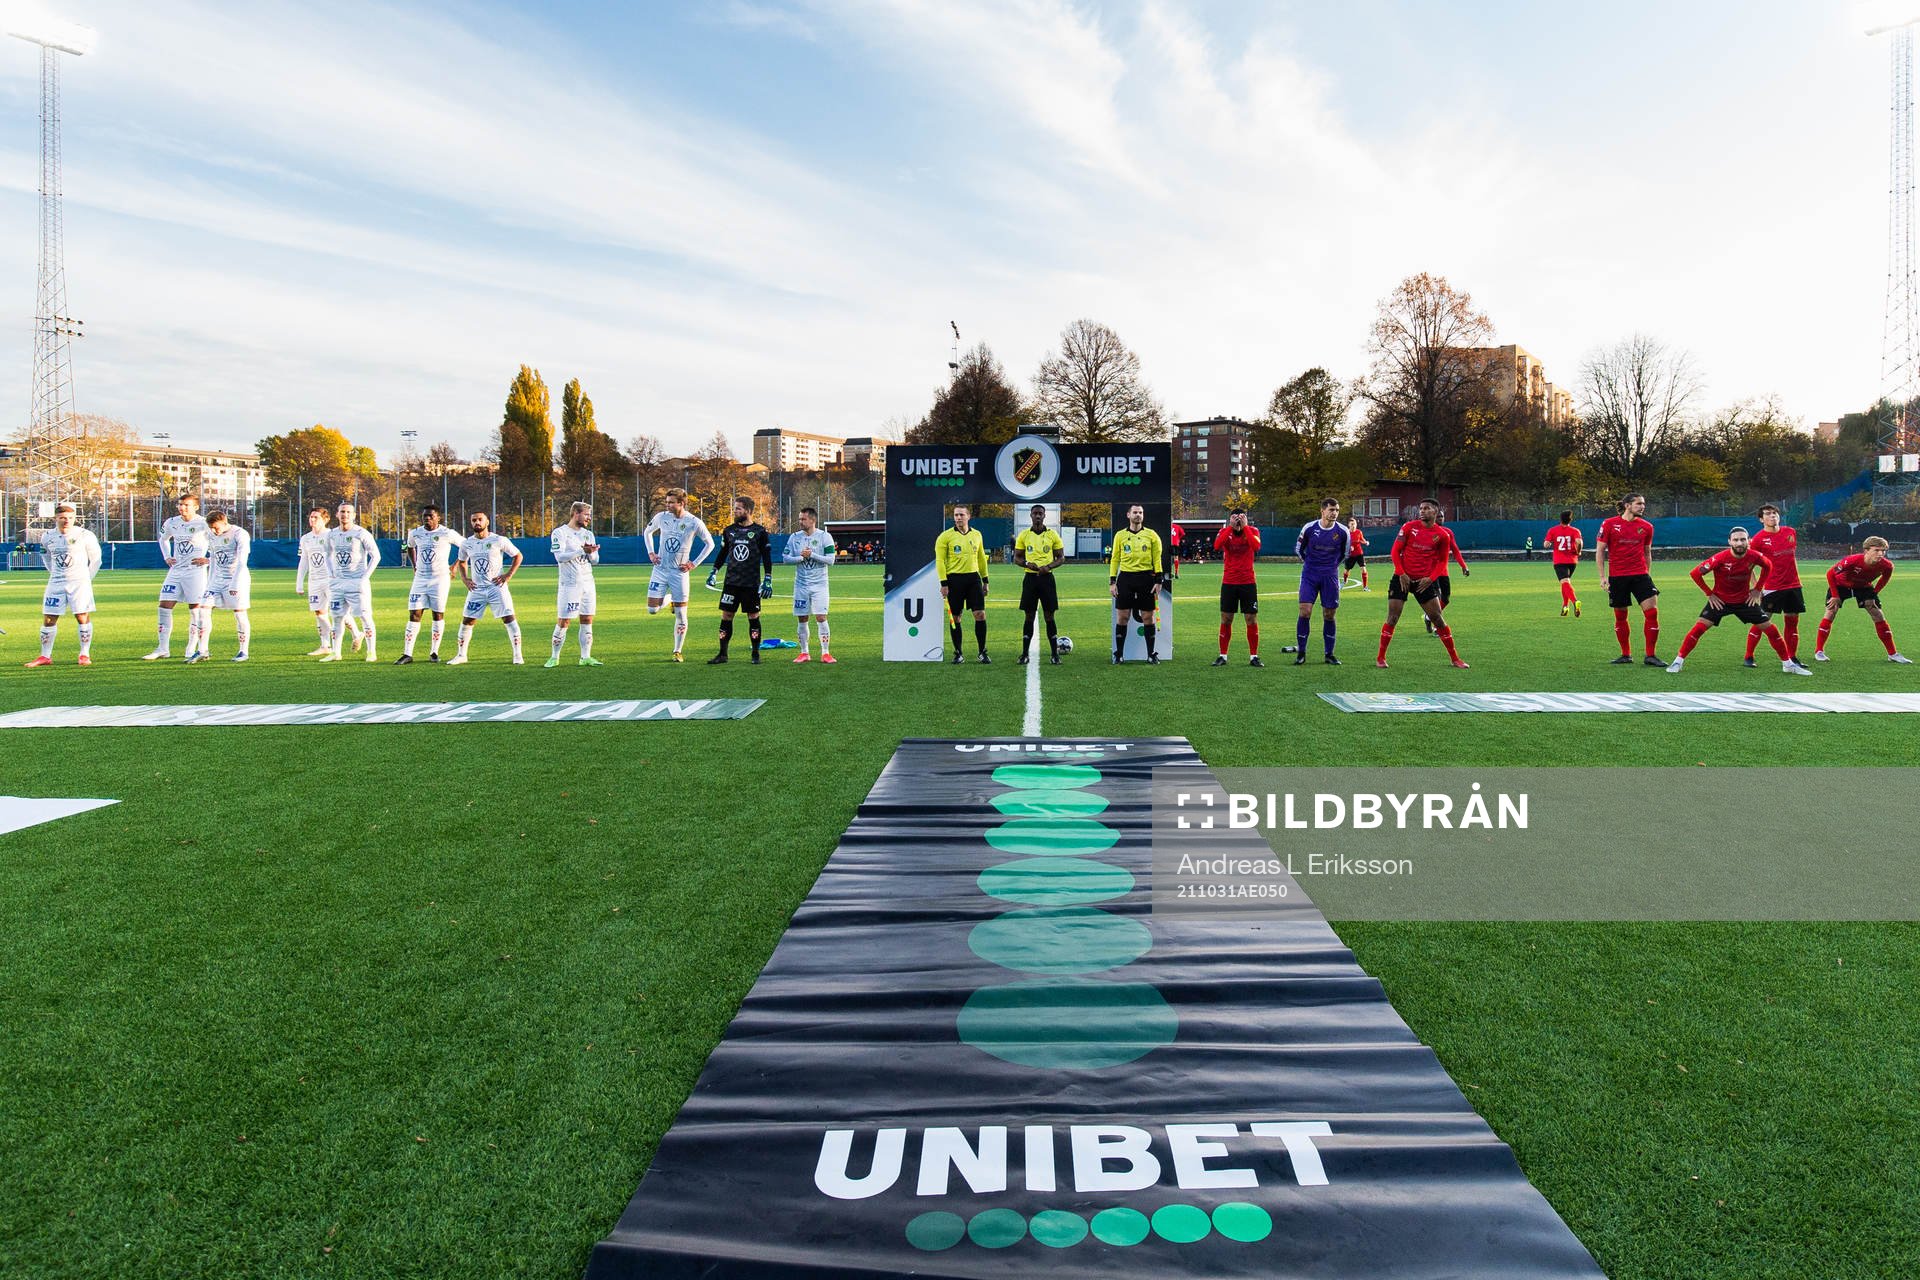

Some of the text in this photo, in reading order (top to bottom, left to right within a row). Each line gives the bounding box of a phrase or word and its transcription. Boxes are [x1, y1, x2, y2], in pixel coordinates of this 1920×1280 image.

[901, 458, 978, 475] UNIBET
[1076, 456, 1155, 474] UNIBET
[1557, 536, 1571, 551] 21
[904, 598, 924, 624] U
[136, 700, 713, 724] SUPERETTAN
[954, 743, 1135, 752] UNIBET
[814, 1121, 1335, 1200] UNIBET
